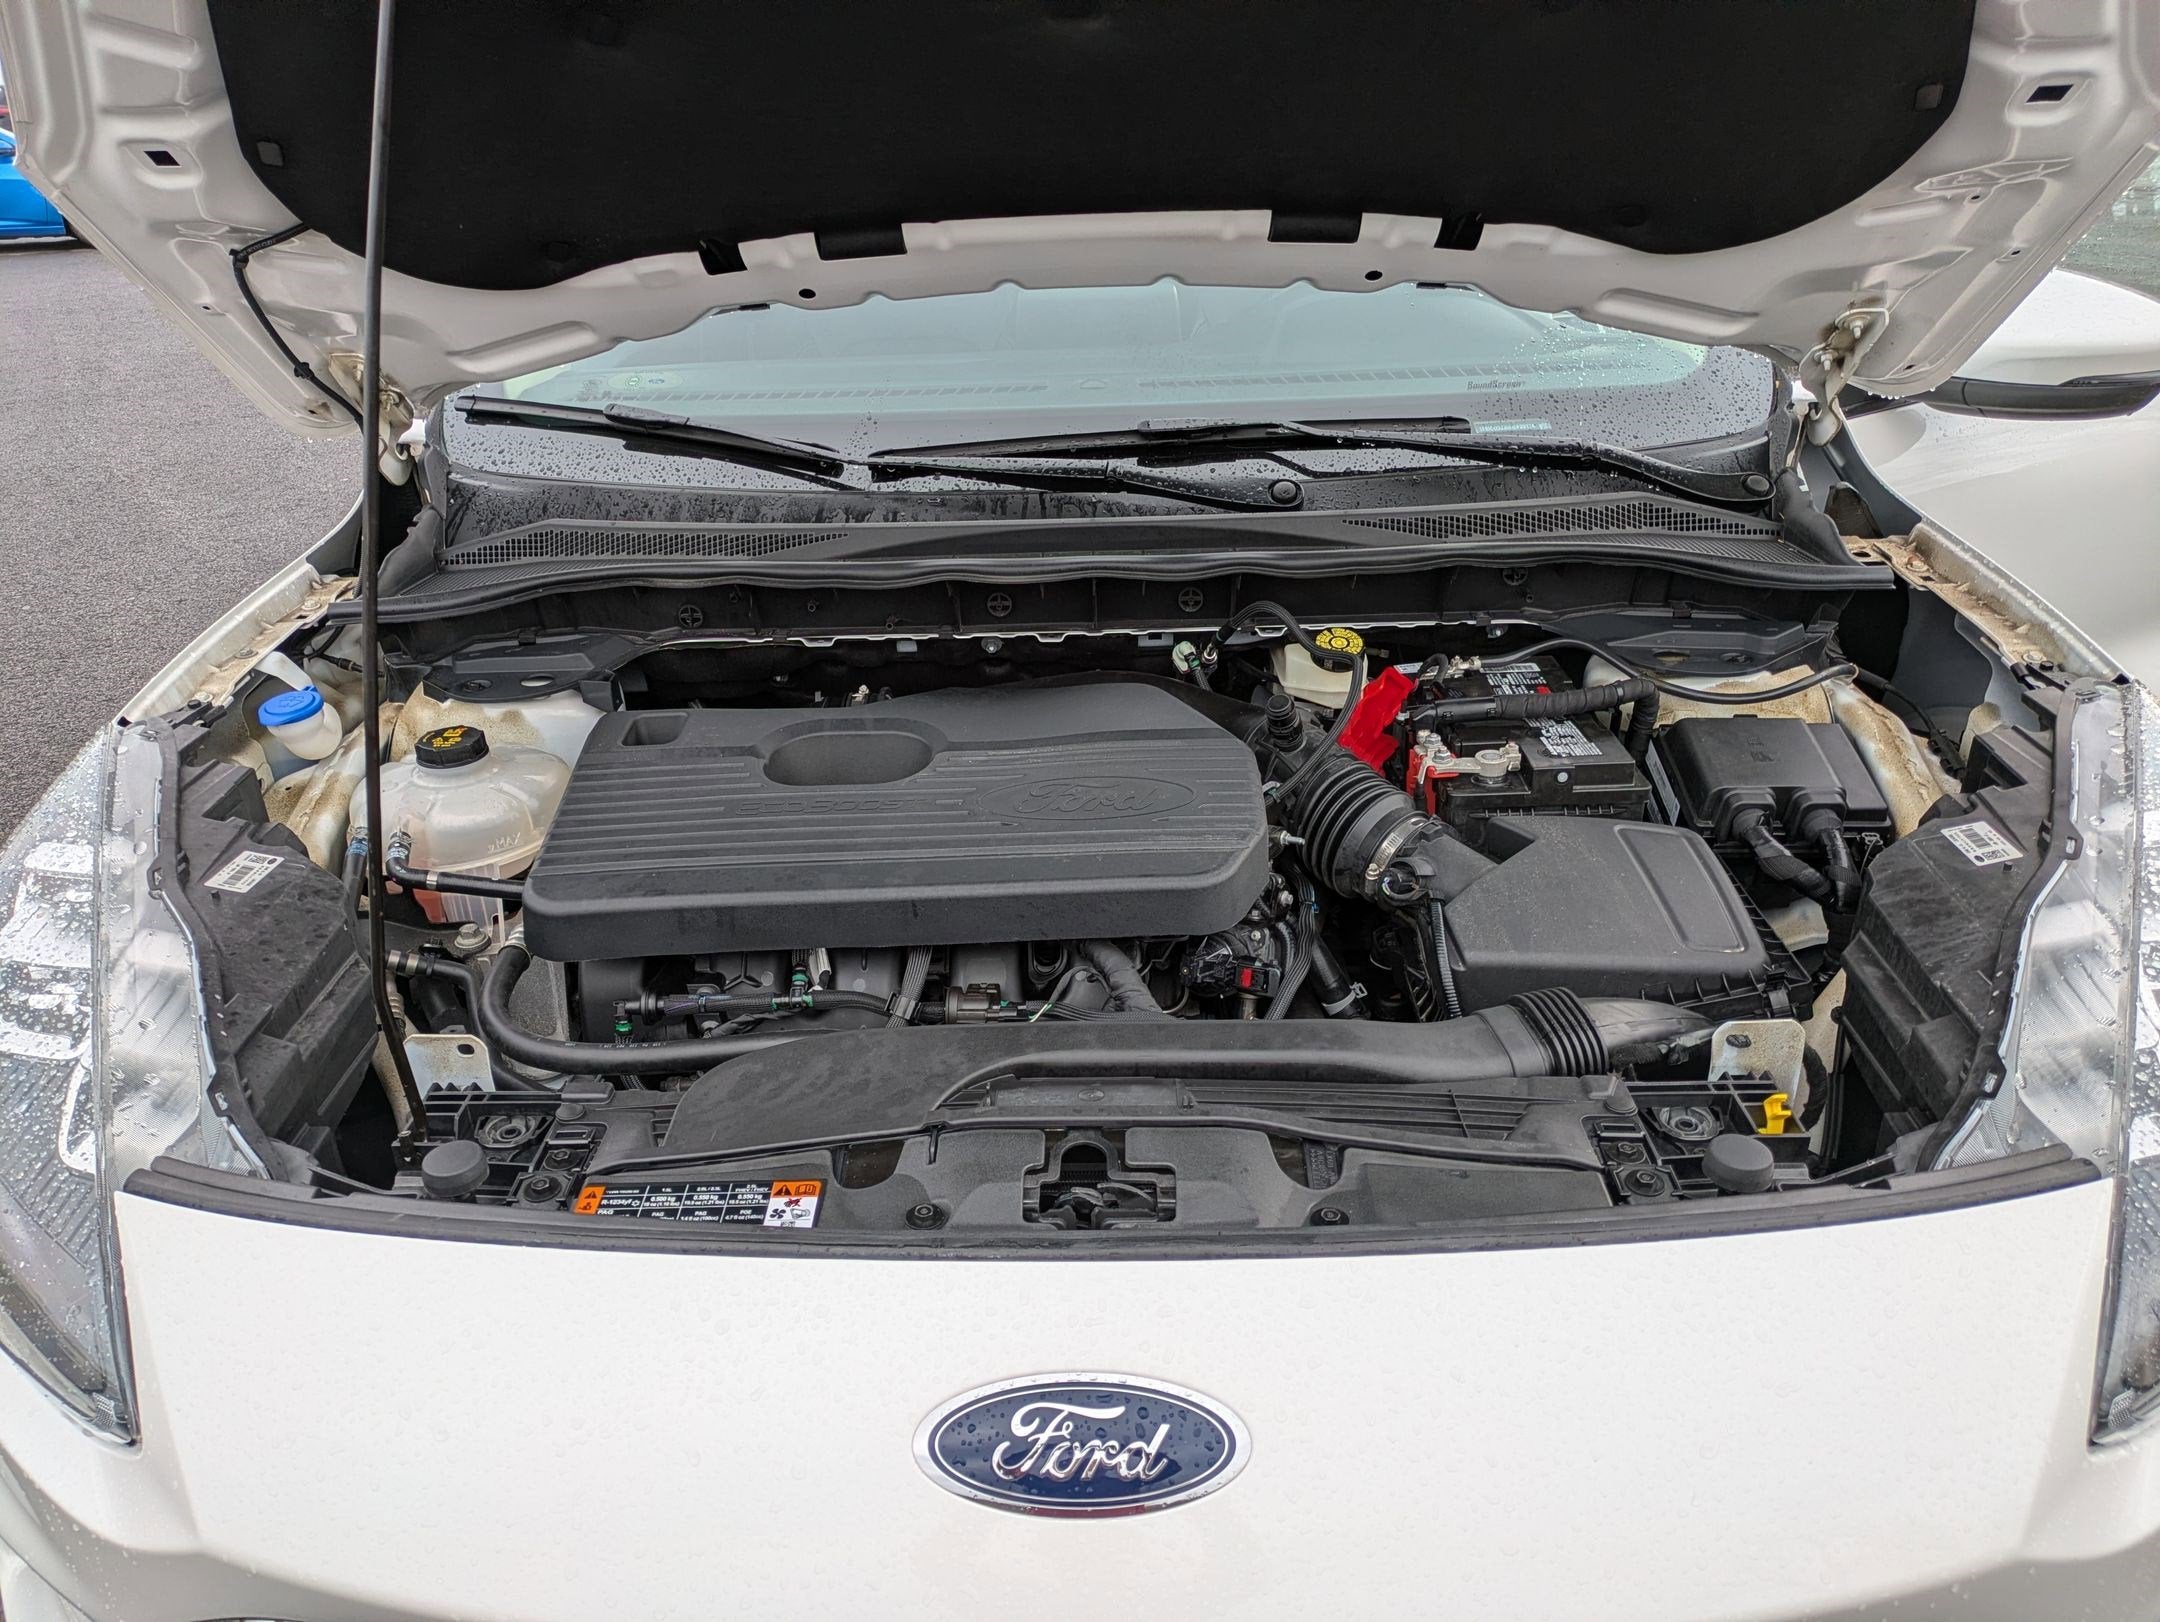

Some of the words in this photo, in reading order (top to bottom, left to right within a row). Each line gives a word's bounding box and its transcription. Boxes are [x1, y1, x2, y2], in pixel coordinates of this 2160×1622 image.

[1013, 783, 1158, 814] Ford
[710, 1194, 719, 1202] kg
[992, 1402, 1171, 1483] Ford
